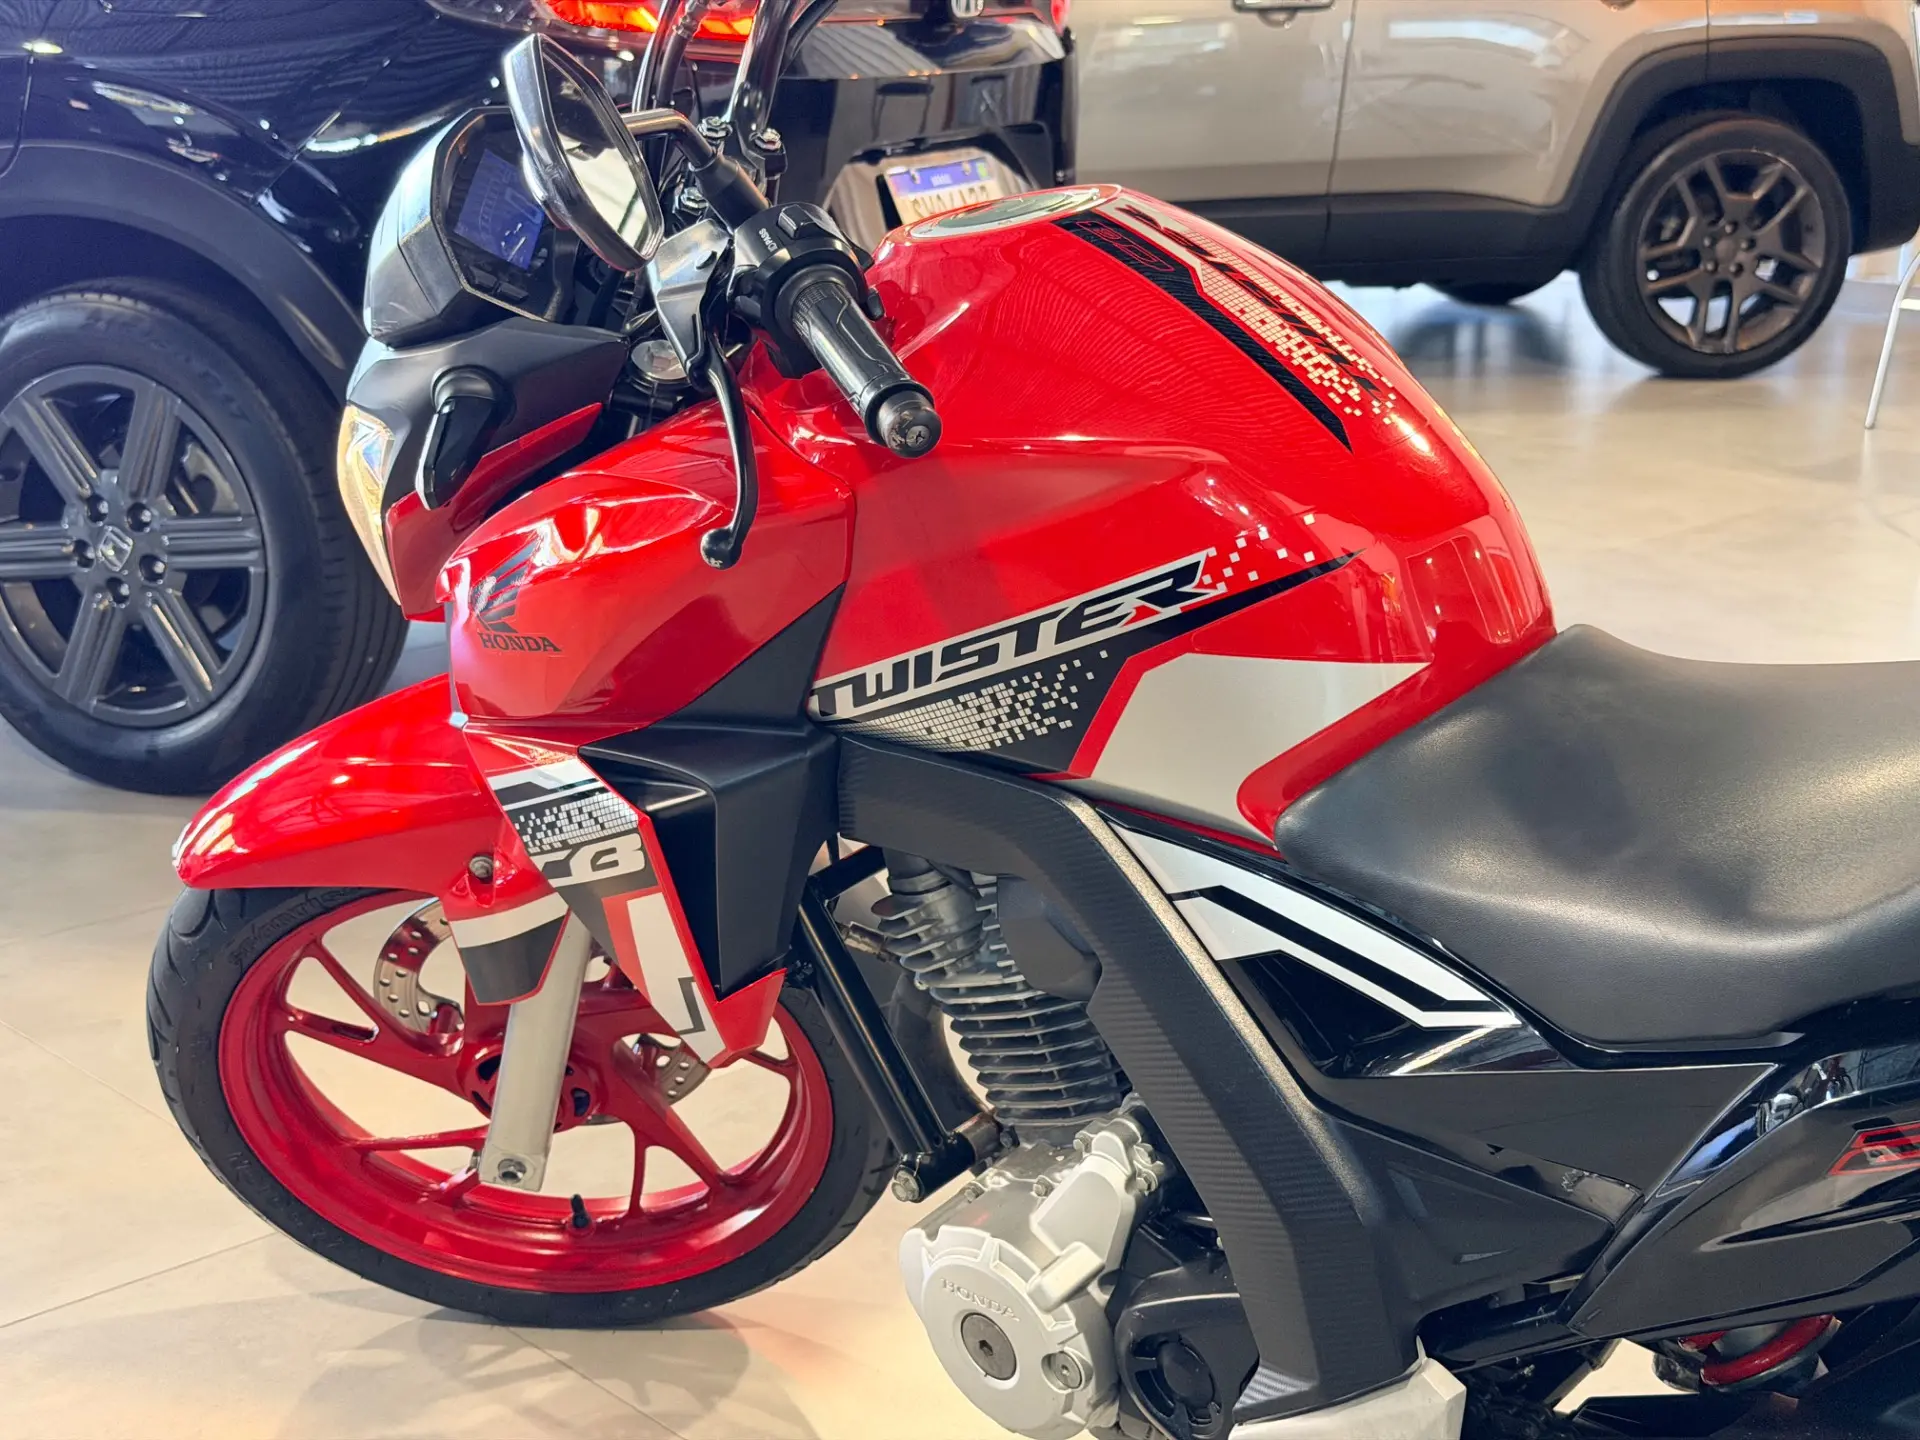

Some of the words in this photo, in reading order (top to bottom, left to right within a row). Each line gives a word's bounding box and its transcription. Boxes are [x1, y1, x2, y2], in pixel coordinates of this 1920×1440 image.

[758, 228, 773, 246] PASS
[479, 632, 562, 652] HONDA
[809, 550, 1224, 719] TWISTER
[941, 1278, 1020, 1322] HONDA
